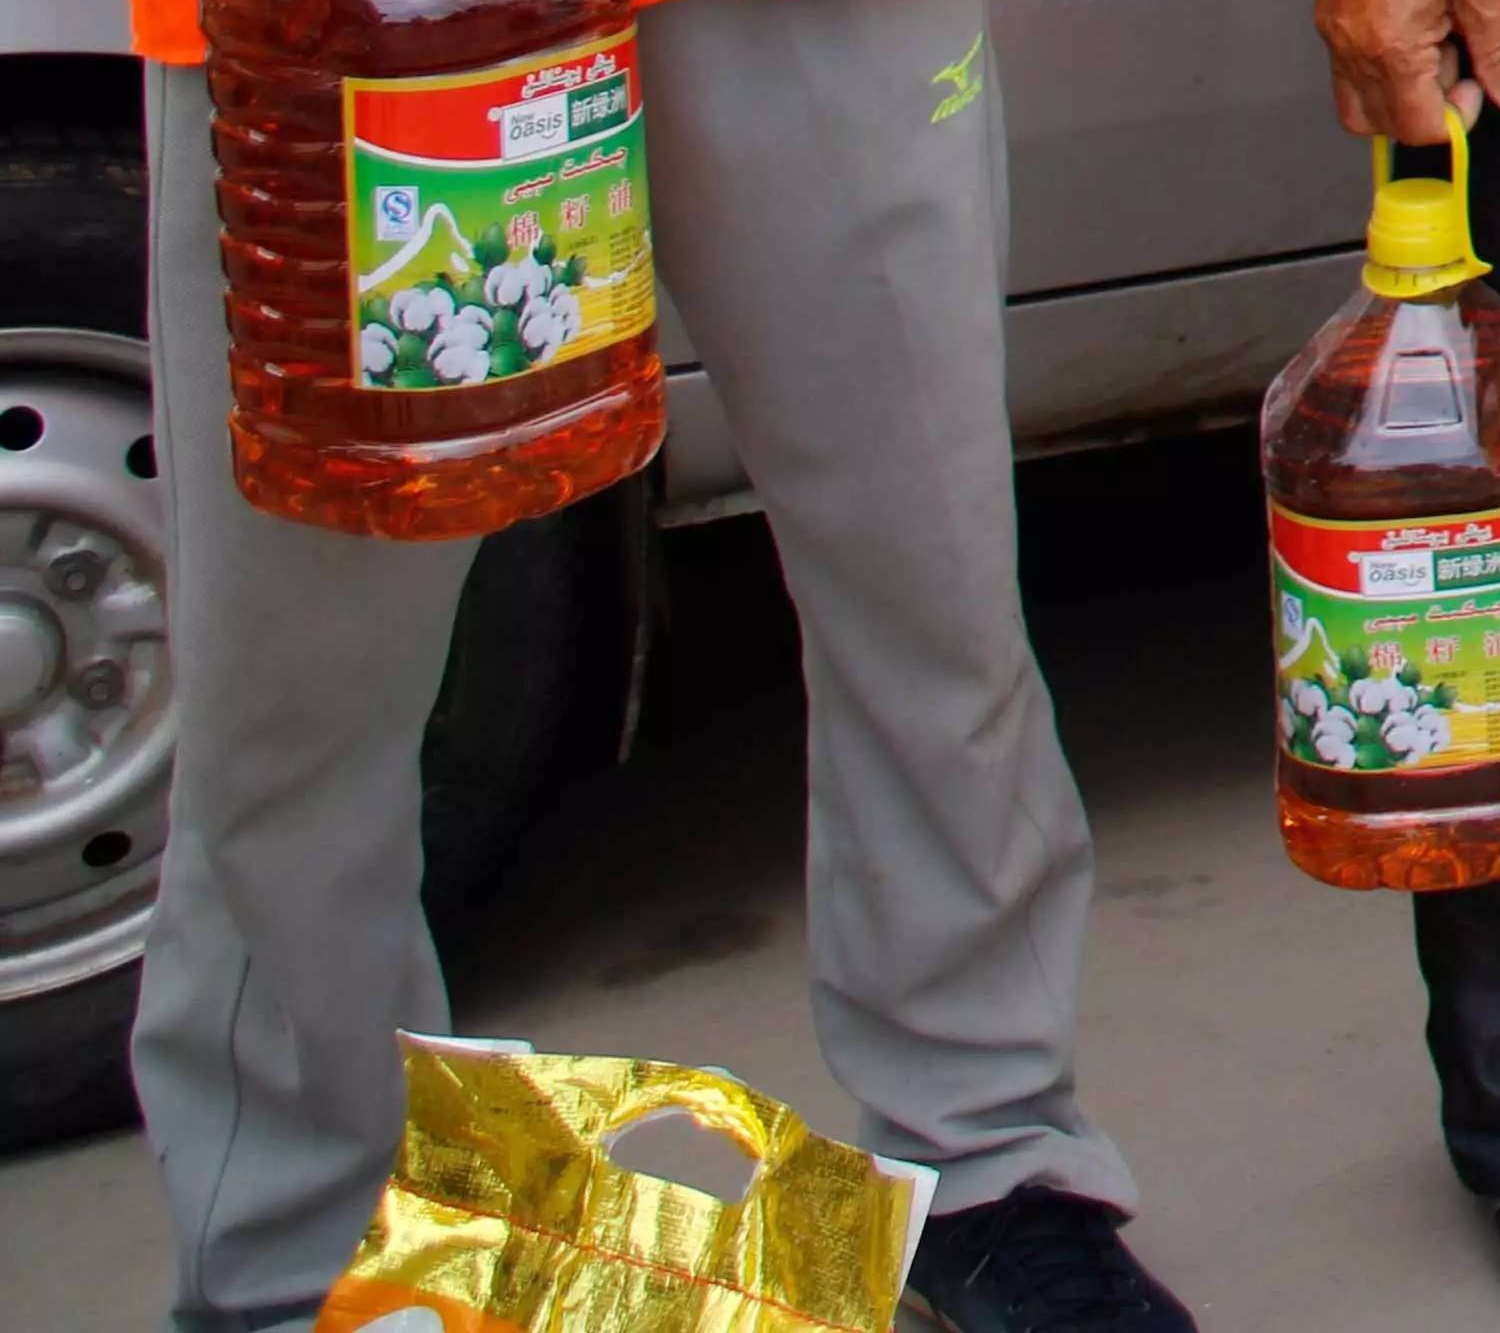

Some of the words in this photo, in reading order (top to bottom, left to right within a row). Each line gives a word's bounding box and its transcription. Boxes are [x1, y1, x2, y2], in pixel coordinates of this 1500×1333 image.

[571, 84, 628, 129] 新绿洲
[510, 112, 563, 140] oasis
[507, 178, 633, 249] 棉籽油
[1369, 562, 1427, 583] oasis
